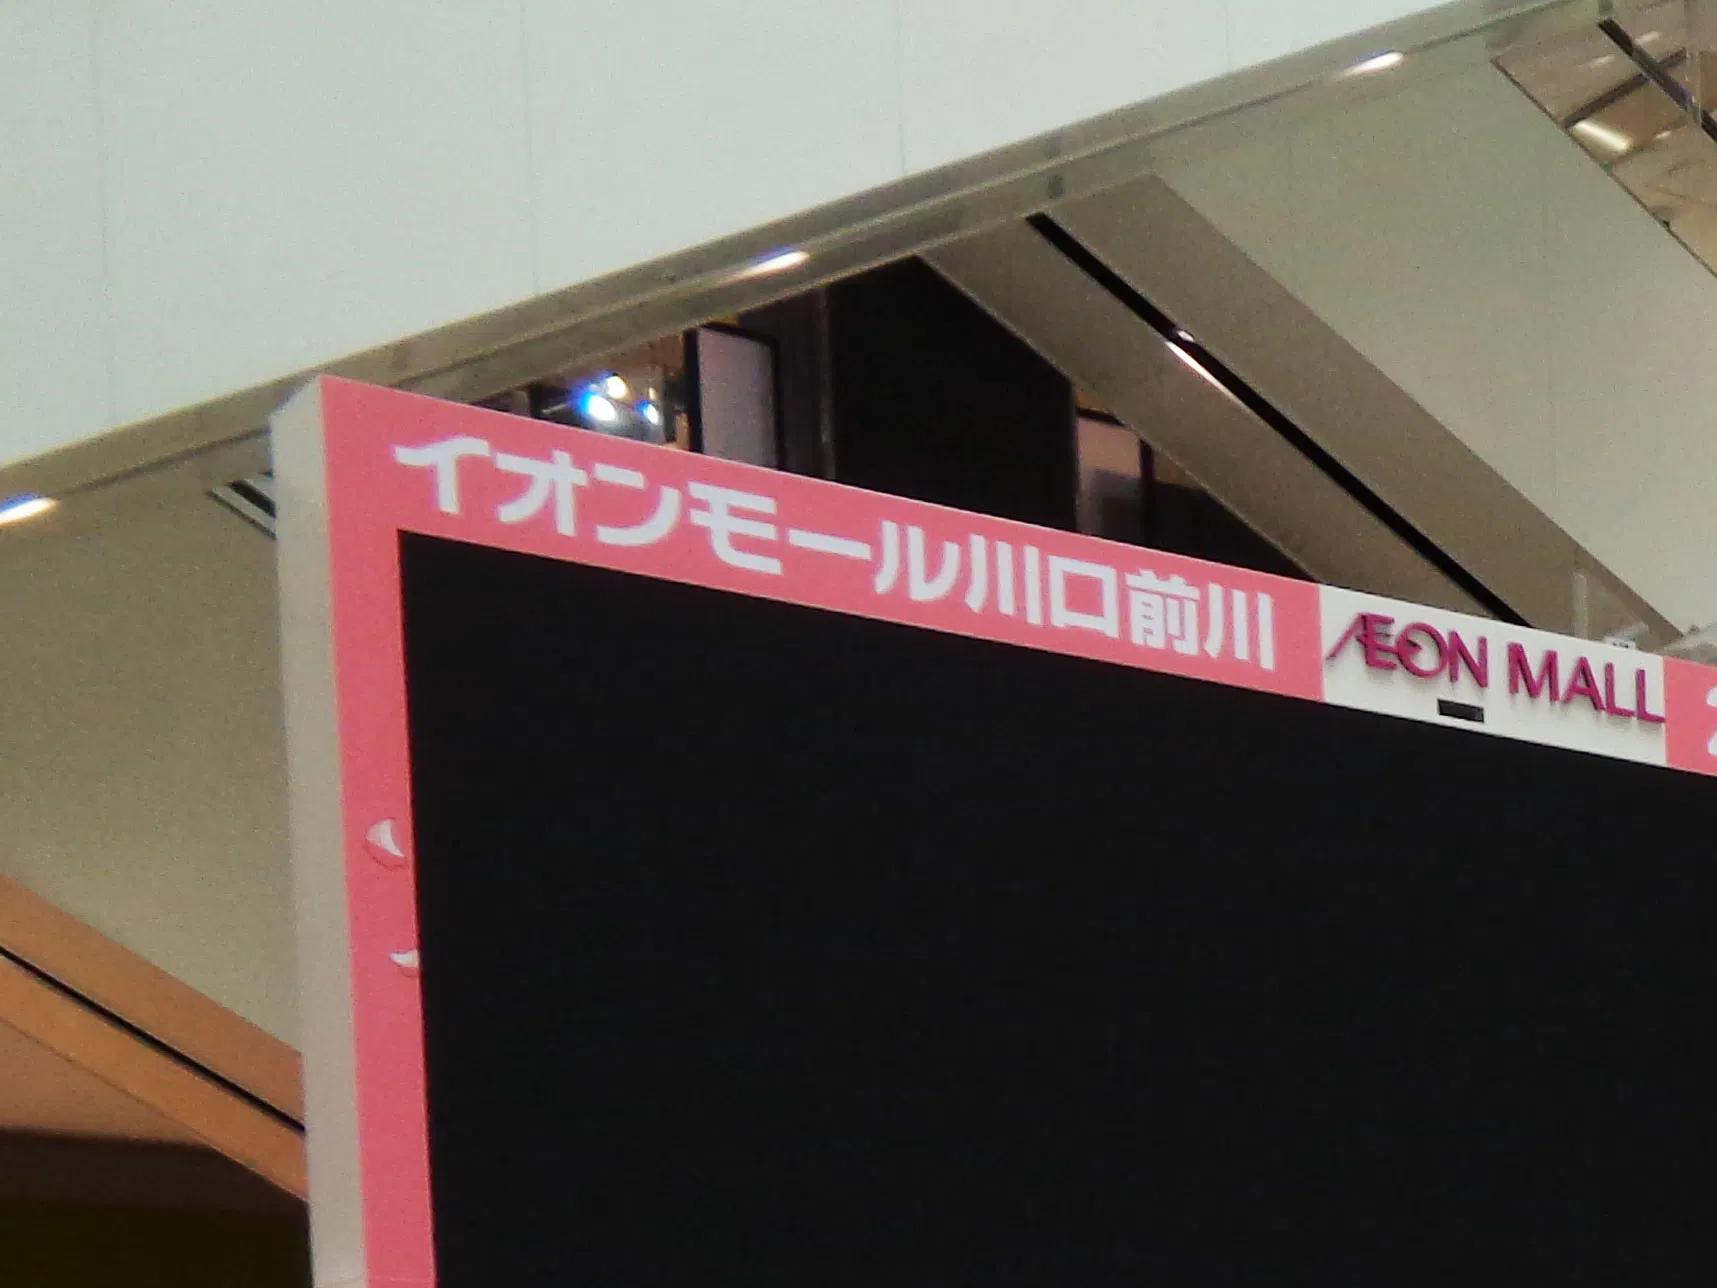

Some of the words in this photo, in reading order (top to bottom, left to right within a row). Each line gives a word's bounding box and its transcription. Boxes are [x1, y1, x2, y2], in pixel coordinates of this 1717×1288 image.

[394, 434, 1277, 671] イオンモール川口前川
[1508, 643, 1665, 724] MALL
